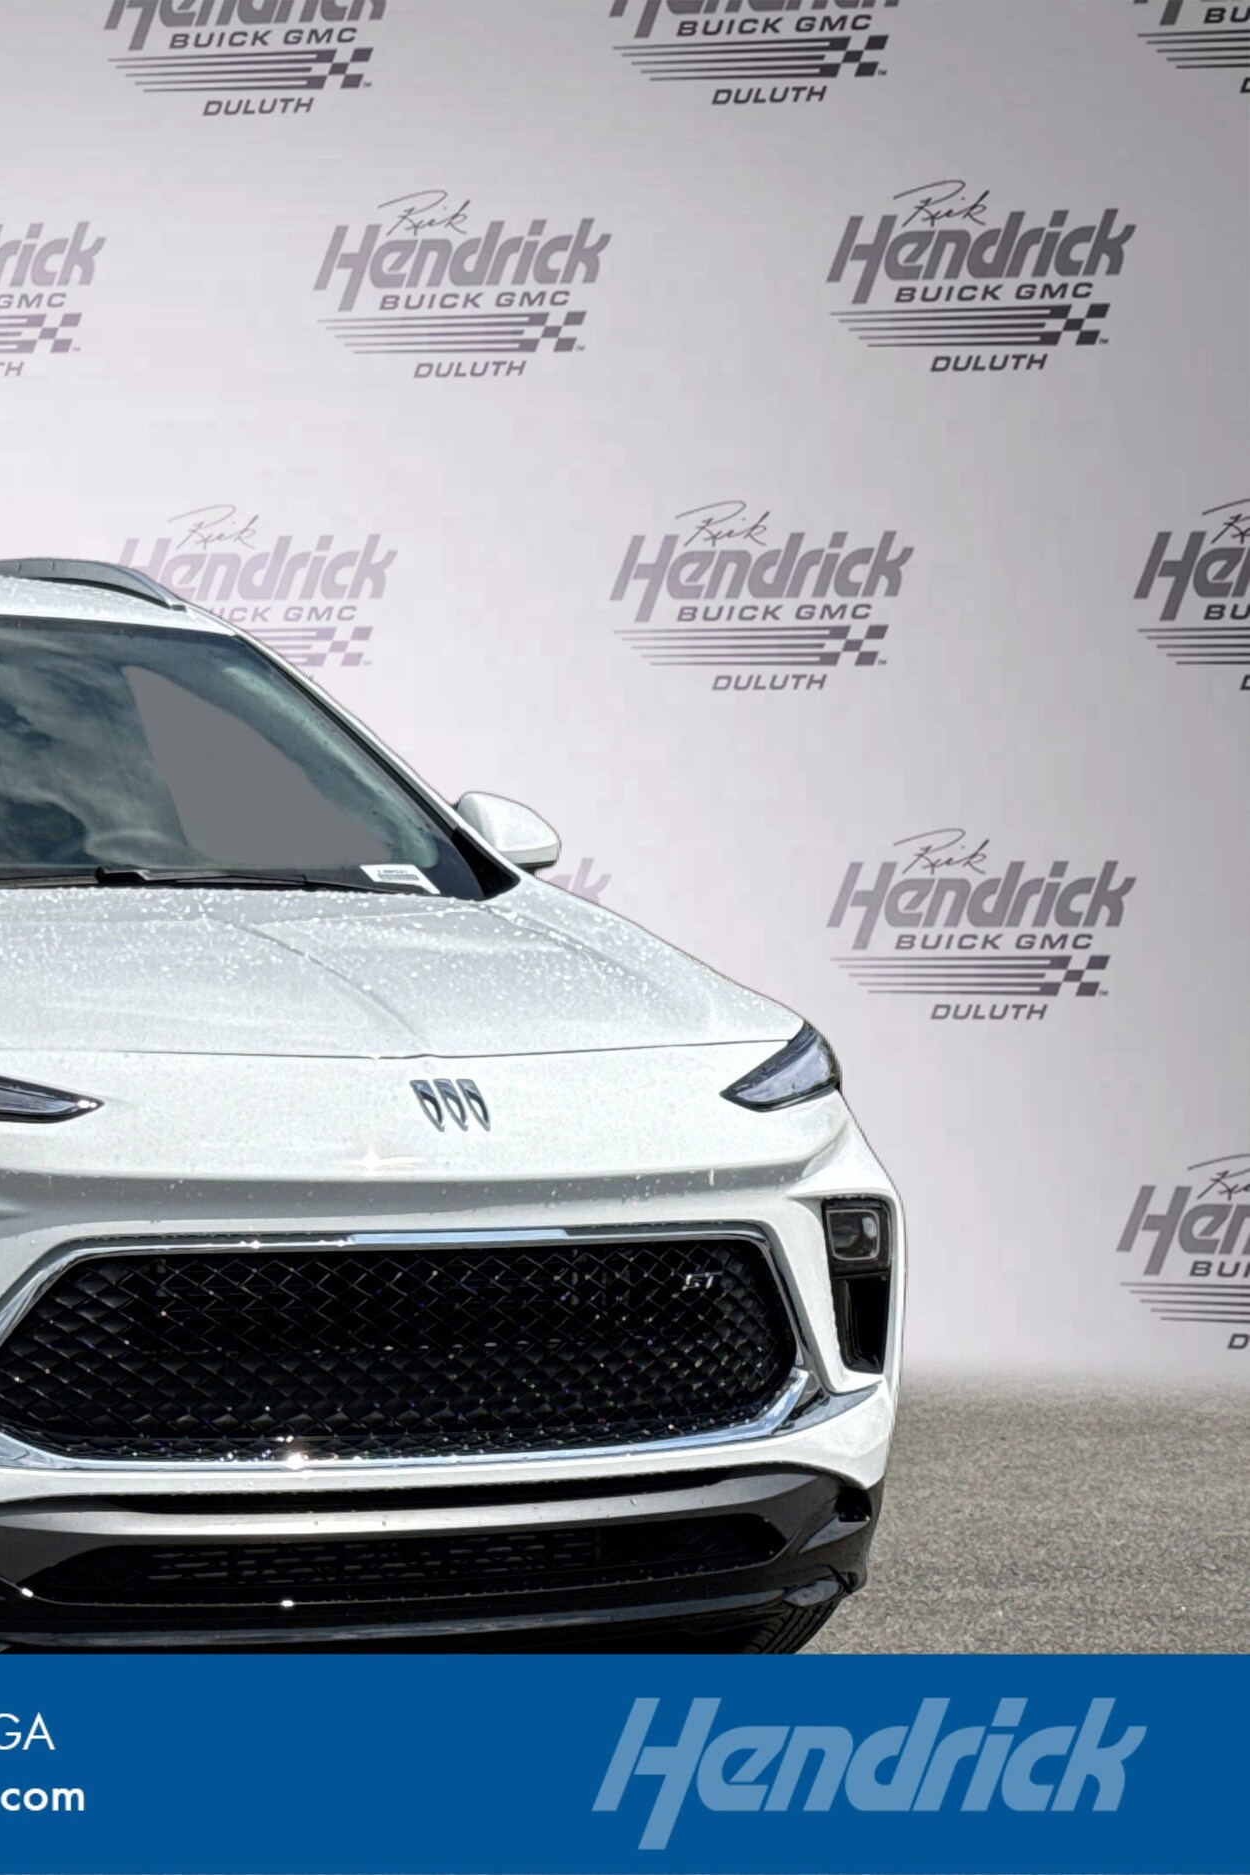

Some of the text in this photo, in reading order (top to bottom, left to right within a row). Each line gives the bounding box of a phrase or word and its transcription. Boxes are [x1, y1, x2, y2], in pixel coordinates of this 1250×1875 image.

[676, 14, 873, 37] BUICK GMC
[169, 27, 357, 49] BUICK GMC
[711, 85, 827, 105] DULUTH
[202, 97, 314, 116] DULUTH
[313, 218, 612, 312] Hendrick
[825, 208, 1137, 304] Hendrick
[379, 290, 571, 310] BUICK GMC
[894, 282, 1094, 303] BUICK GMC
[413, 360, 527, 378] DULUTH
[930, 354, 1048, 372] DULUTH
[608, 530, 915, 623] Hendrick
[209, 605, 358, 622] ICK GMC
[676, 604, 873, 622] BUICK GMC
[711, 674, 828, 691] DULUTH
[826, 860, 1136, 950] Hendrick
[895, 933, 1093, 950] BUICK GMC
[930, 1004, 1048, 1020] DULUTH
[1189, 1260, 1250, 1278] BUI
